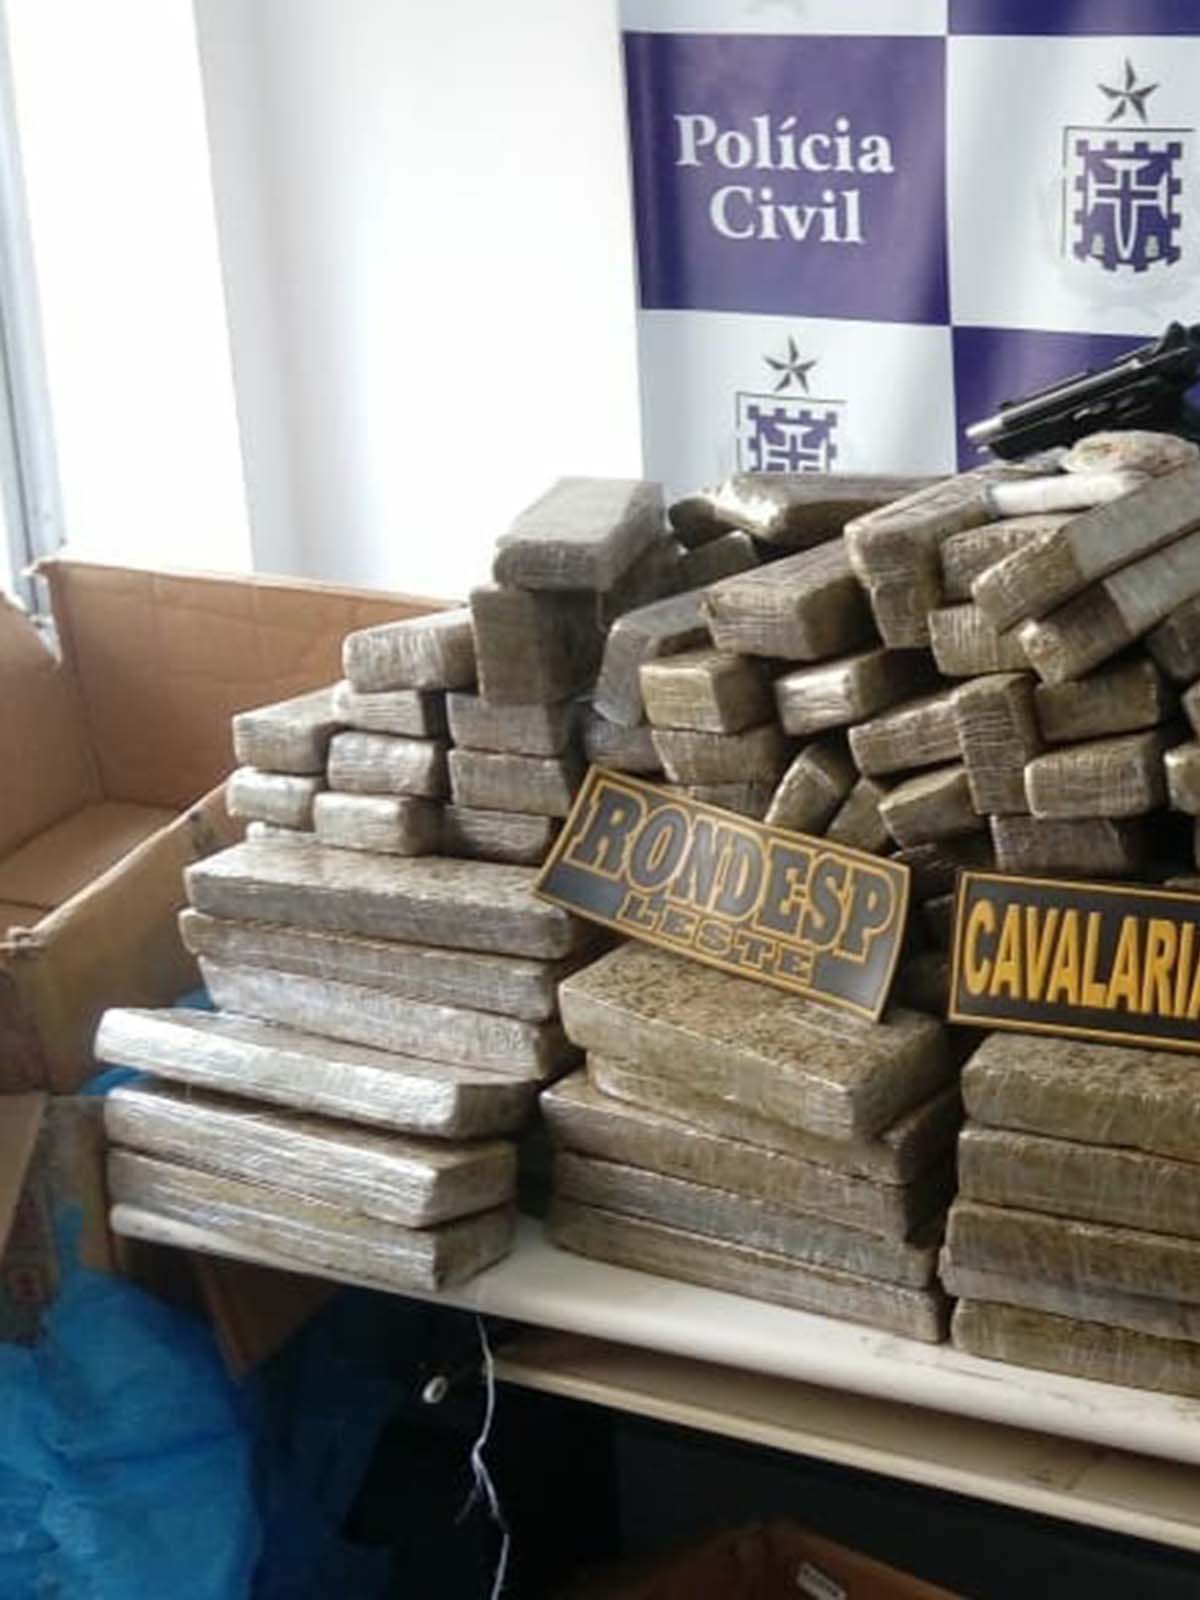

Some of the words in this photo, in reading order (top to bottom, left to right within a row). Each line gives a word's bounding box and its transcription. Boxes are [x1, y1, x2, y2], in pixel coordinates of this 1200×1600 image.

[674, 112, 896, 175] Polícia
[709, 183, 865, 245] Civil
[564, 780, 896, 963] RONDESP
[615, 892, 815, 988] LESTE
